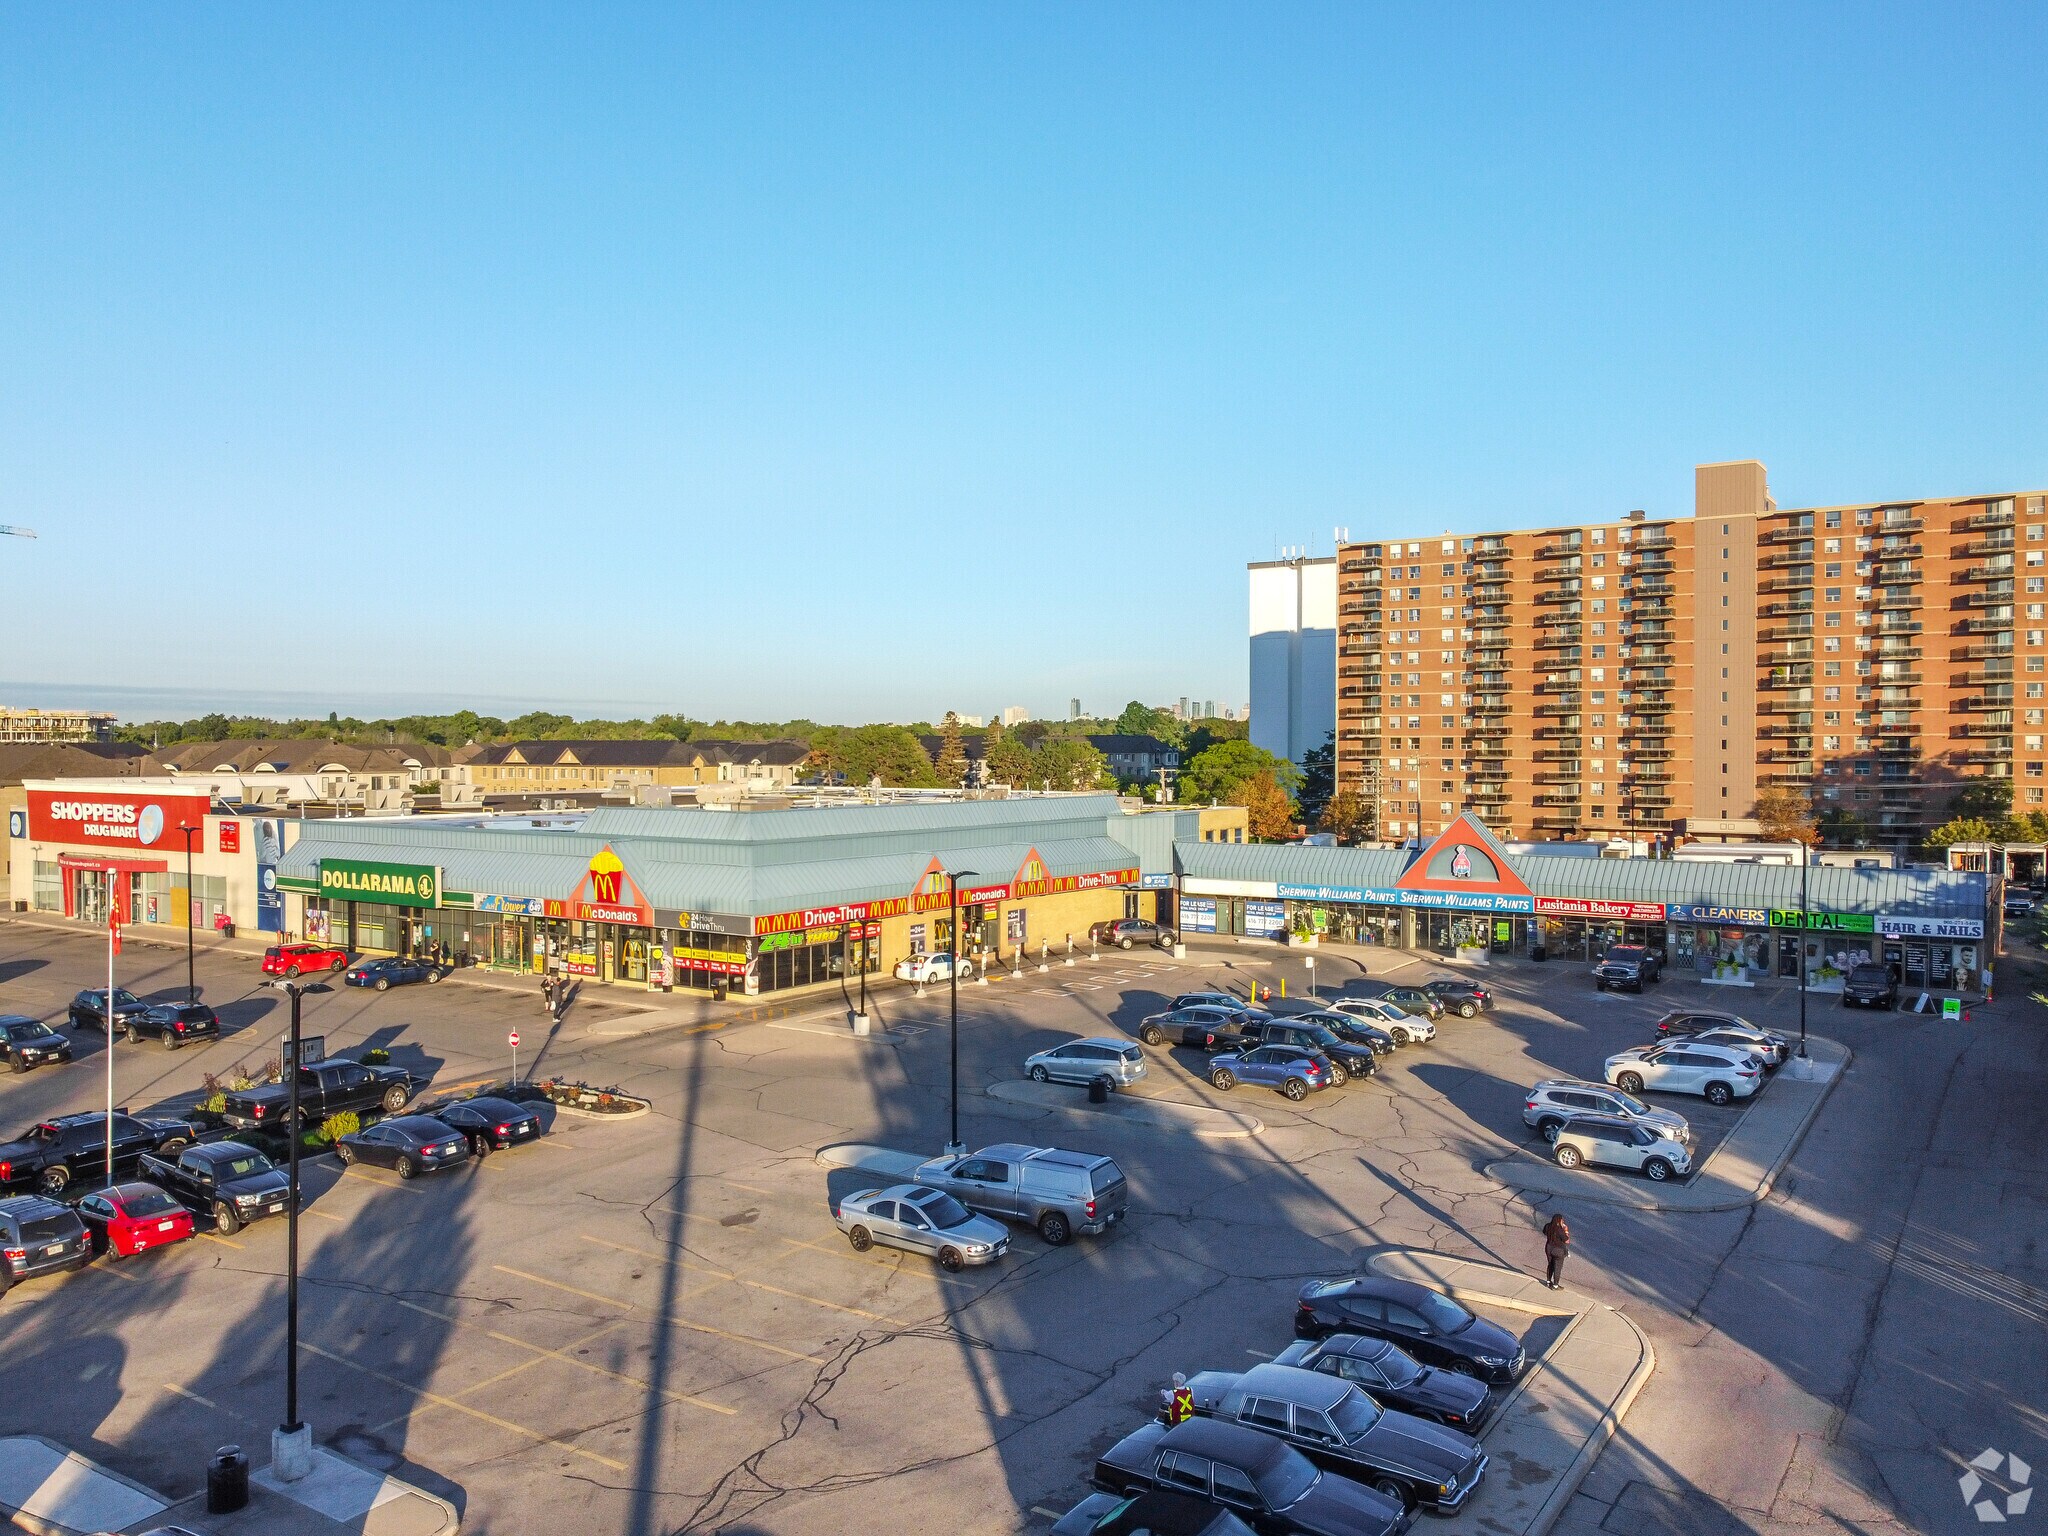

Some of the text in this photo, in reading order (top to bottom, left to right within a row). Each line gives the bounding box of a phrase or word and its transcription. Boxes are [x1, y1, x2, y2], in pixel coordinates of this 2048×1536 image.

[50, 801, 136, 823] SHOPPERS
[84, 824, 137, 838] DRUG MART
[322, 870, 416, 894] DOLLARAMA
[1078, 873, 1117, 888] Drive-Thru
[962, 889, 1006, 904] McDonald's
[1364, 889, 1396, 902] PAINTS
[1495, 897, 1529, 910] PAINTS
[1536, 898, 1588, 913] Lusitania
[1590, 902, 1630, 916] Bakery
[582, 904, 638, 922] McDonald's
[691, 913, 714, 922] 24 Hour
[804, 906, 866, 927] Drive-Thru
[1692, 907, 1765, 921] CLEANERS
[1772, 911, 1845, 929] DENTAL
[1881, 922, 1917, 933] HAIR
[1921, 924, 1932, 934] &
[1937, 925, 1982, 937] NAILS
